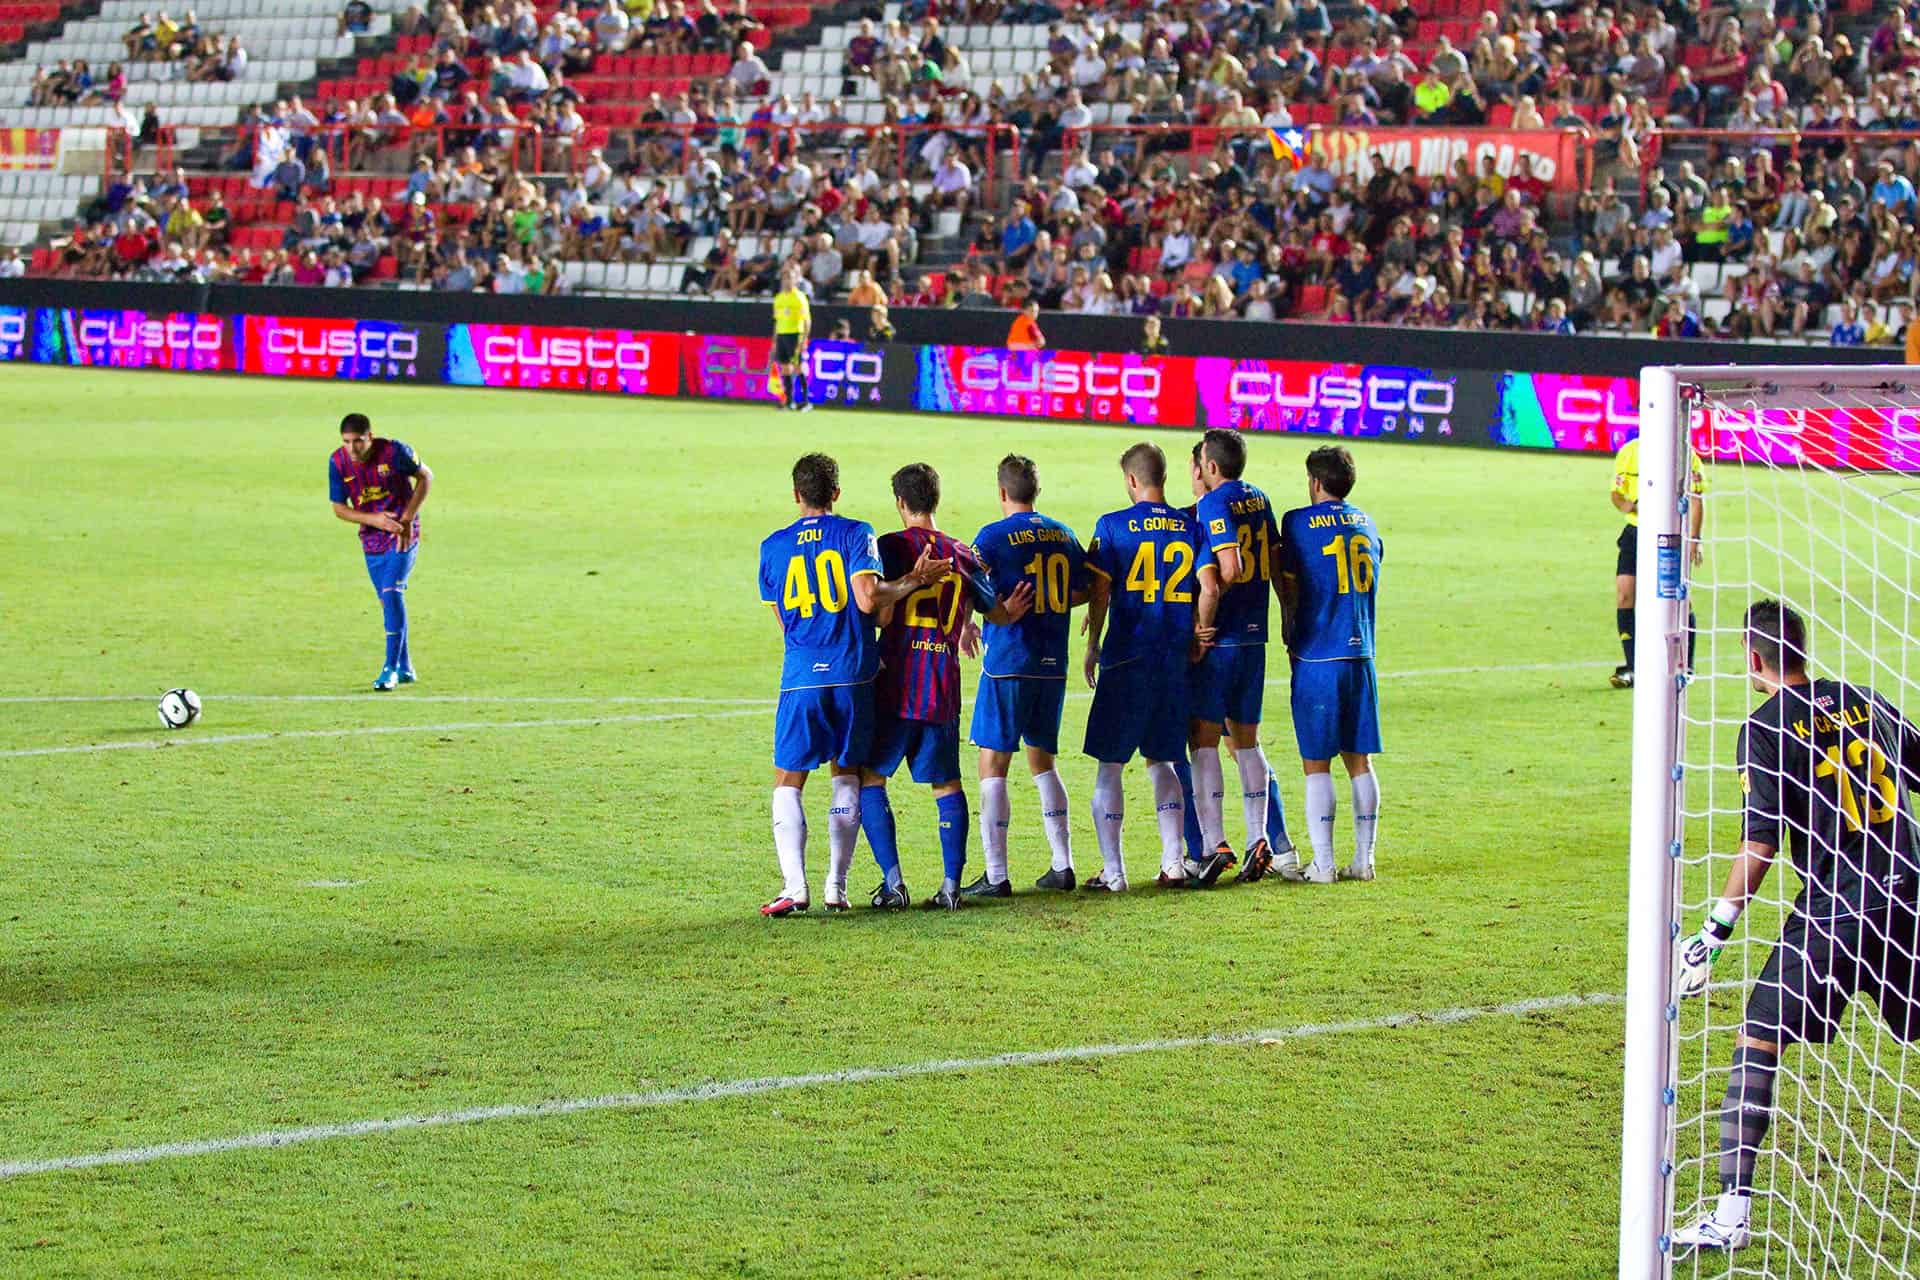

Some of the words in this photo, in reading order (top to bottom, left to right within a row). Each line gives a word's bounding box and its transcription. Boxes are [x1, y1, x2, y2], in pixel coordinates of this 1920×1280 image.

[267, 358, 417, 377] ARCELONA
[1128, 519, 1142, 533] C.
[1143, 516, 1187, 532] GOMEZ
[1308, 513, 1337, 529] JAVI
[796, 528, 823, 545] ZOU
[1007, 528, 1036, 546] LUIS
[1231, 519, 1270, 583] 31
[1126, 540, 1194, 603] 42
[1322, 534, 1374, 594] 16
[783, 549, 849, 618] 40
[1023, 552, 1070, 614] 10
[911, 638, 947, 654] unicef
[1814, 702, 1878, 734] CASLL
[1814, 737, 1898, 832] 13
[829, 807, 850, 815] CDE
